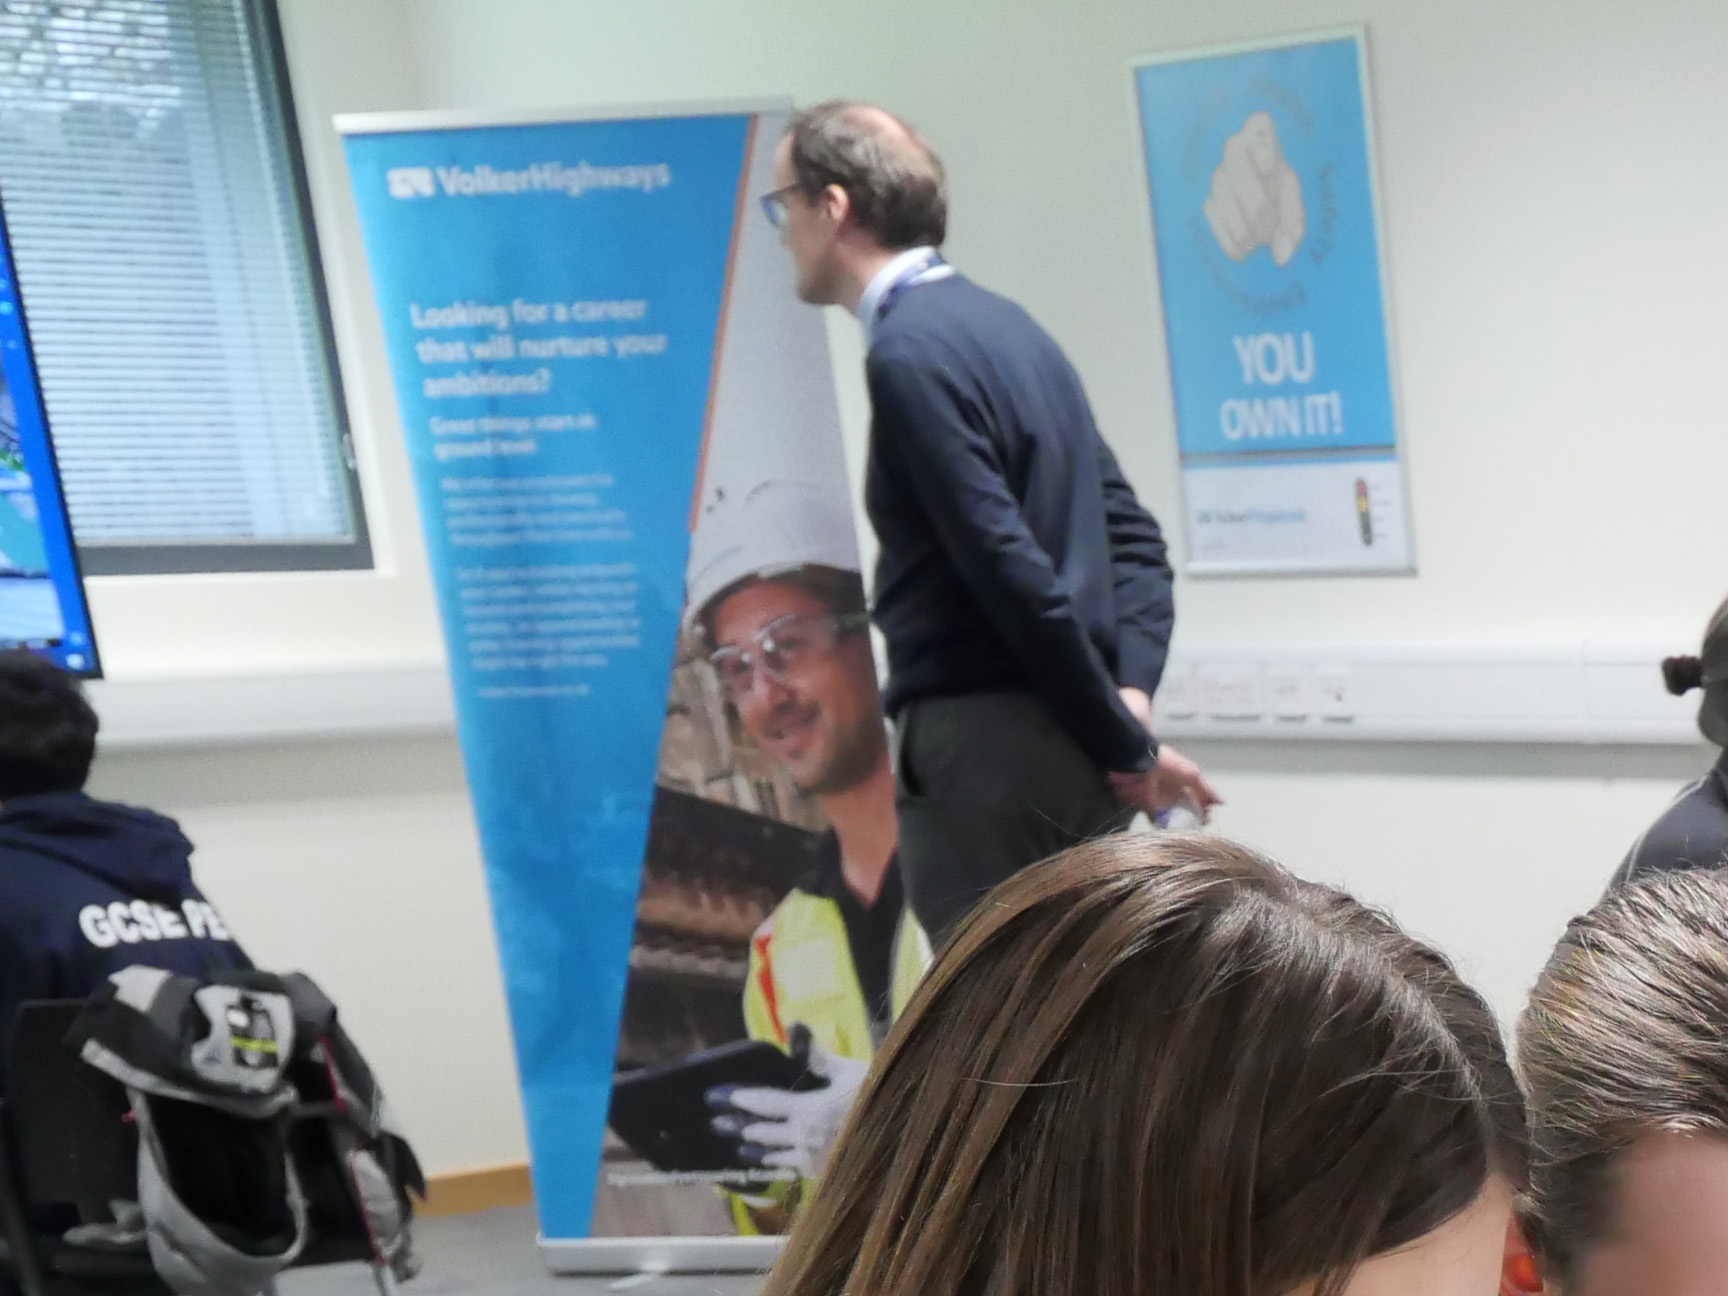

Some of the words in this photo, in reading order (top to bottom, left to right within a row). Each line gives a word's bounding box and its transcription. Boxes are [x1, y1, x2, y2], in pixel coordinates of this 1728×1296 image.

[437, 160, 671, 197] VolkerHighways
[409, 301, 511, 331] Looking
[512, 298, 548, 325] for
[553, 304, 570, 323] a
[571, 300, 647, 322] career
[416, 337, 470, 364] that
[471, 333, 515, 360] will
[519, 336, 610, 359] nurture
[612, 333, 668, 359] your
[1232, 330, 1316, 386] YOU
[422, 367, 551, 399] ambitions?
[1220, 397, 1301, 440] OWN
[1304, 390, 1344, 435] IT!
[78, 899, 189, 949] GCSE
